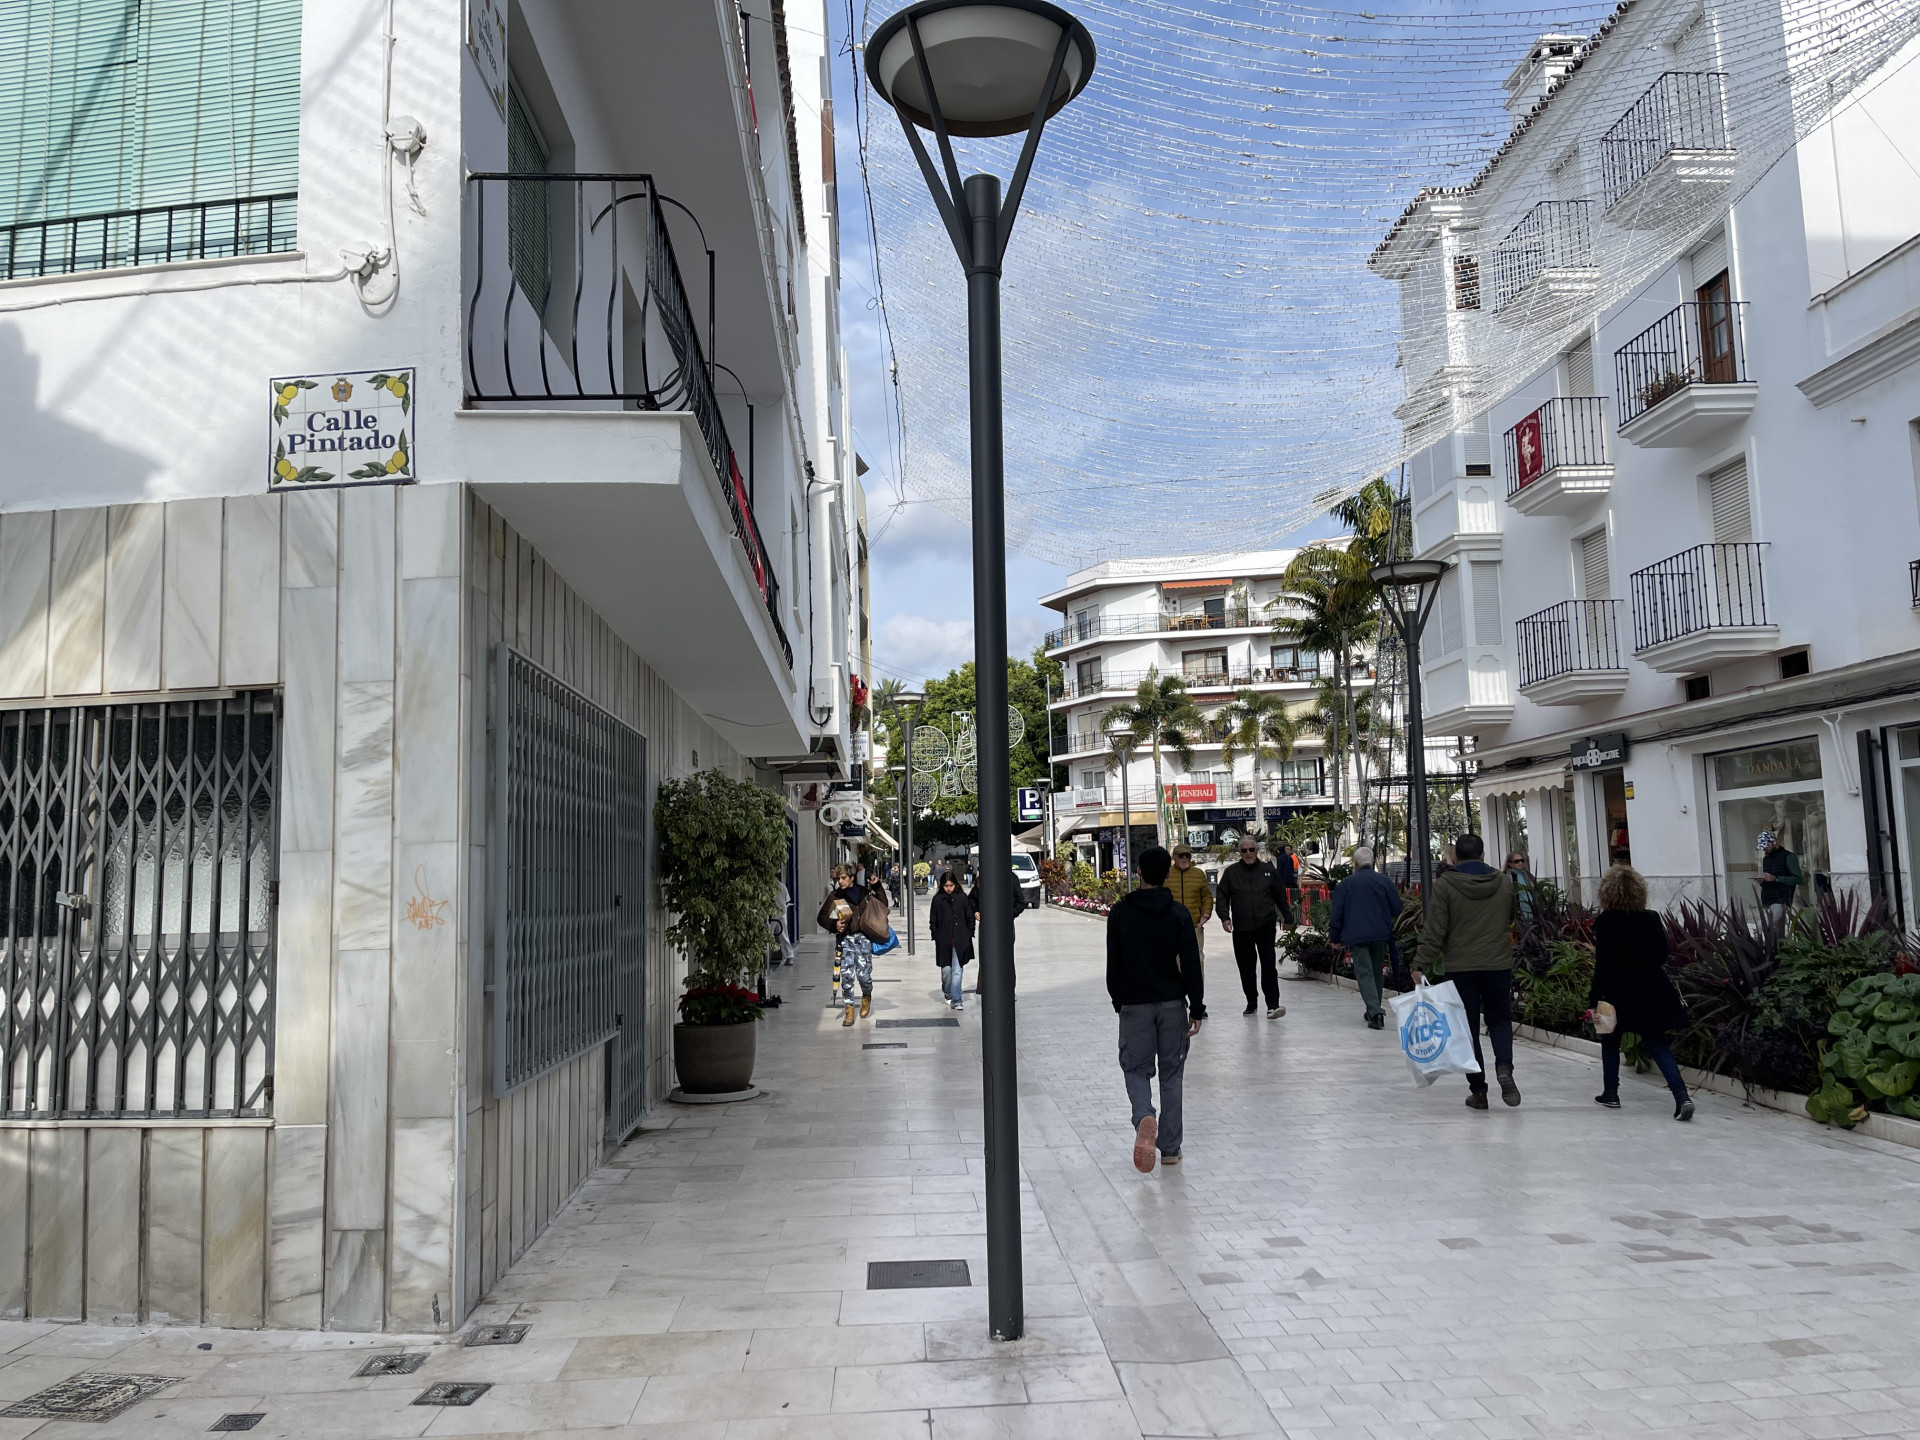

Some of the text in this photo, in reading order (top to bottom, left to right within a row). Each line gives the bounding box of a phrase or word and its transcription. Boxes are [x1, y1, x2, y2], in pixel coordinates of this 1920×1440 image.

[306, 410, 378, 433] Calle
[287, 430, 396, 455] Pintado
[1747, 757, 1802, 776] DANDARA
[1025, 789, 1040, 809] P
[1178, 788, 1214, 798] GENERALI
[1225, 809, 1247, 818] MAGIC
[1248, 808, 1281, 817] SCSORS
[1401, 1014, 1451, 1050] KIDS
